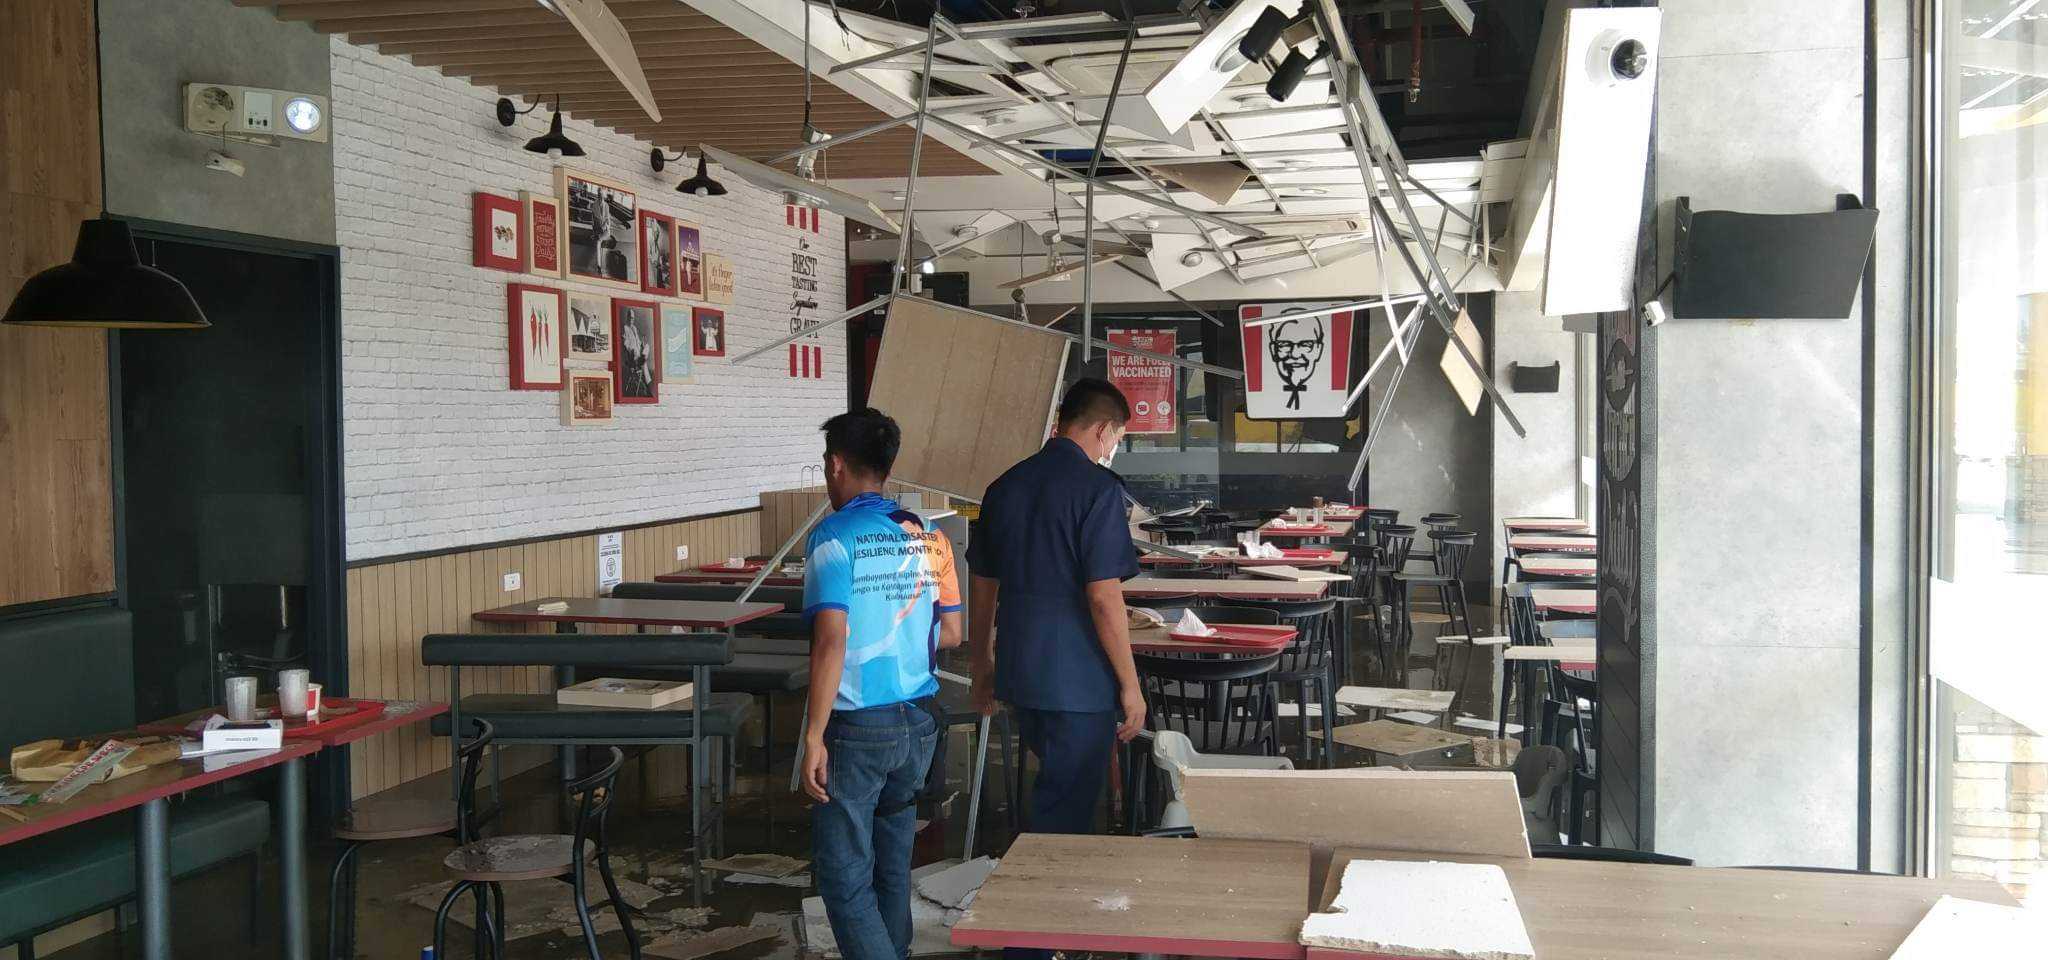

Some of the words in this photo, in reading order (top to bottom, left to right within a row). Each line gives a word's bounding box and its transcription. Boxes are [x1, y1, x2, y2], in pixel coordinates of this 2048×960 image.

[791, 252, 818, 277] BEST
[791, 276, 818, 292] TASTING
[1112, 355, 1126, 366] WE
[1127, 355, 1145, 366] ARE
[1112, 366, 1172, 377] VACCINATED
[856, 532, 899, 545] NATIONAL
